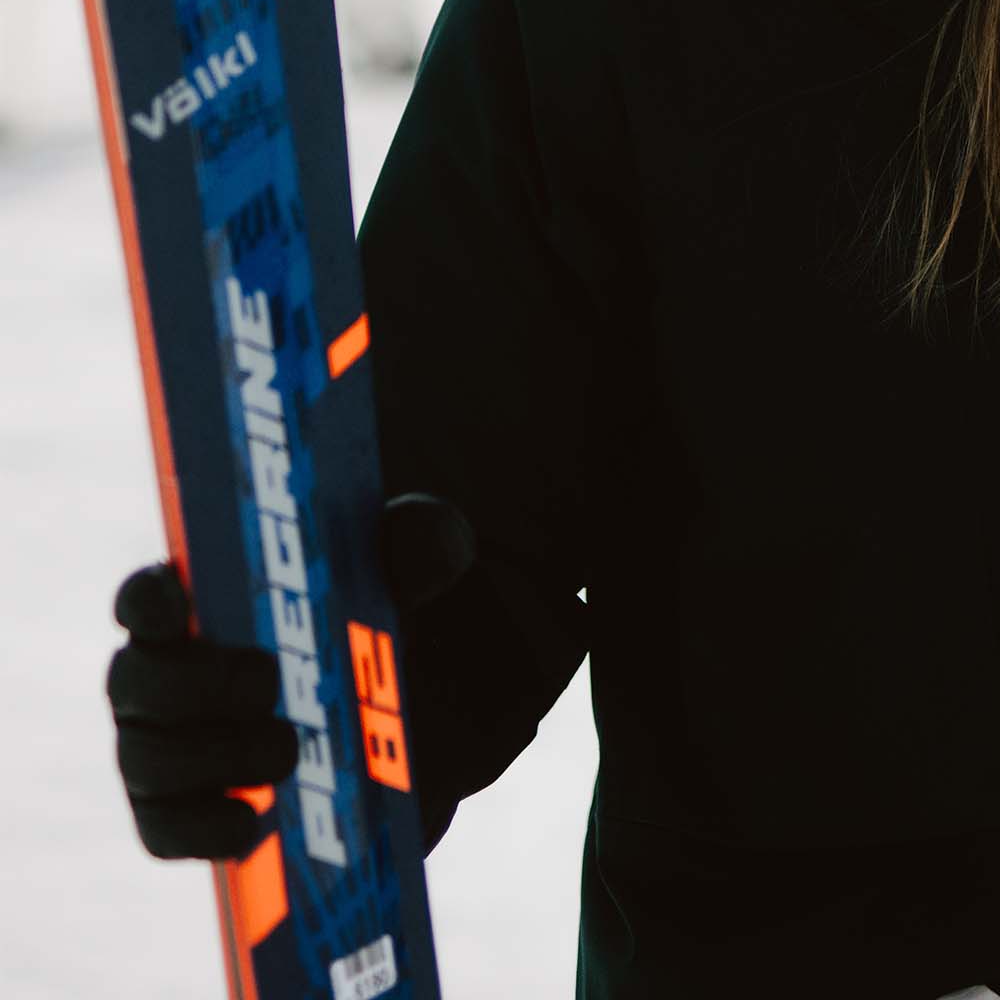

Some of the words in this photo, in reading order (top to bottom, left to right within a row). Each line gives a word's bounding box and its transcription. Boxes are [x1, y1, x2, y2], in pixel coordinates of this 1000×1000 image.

[130, 31, 257, 142] Völkl
[225, 275, 347, 868] PEREGRINE
[346, 619, 412, 793] 82
